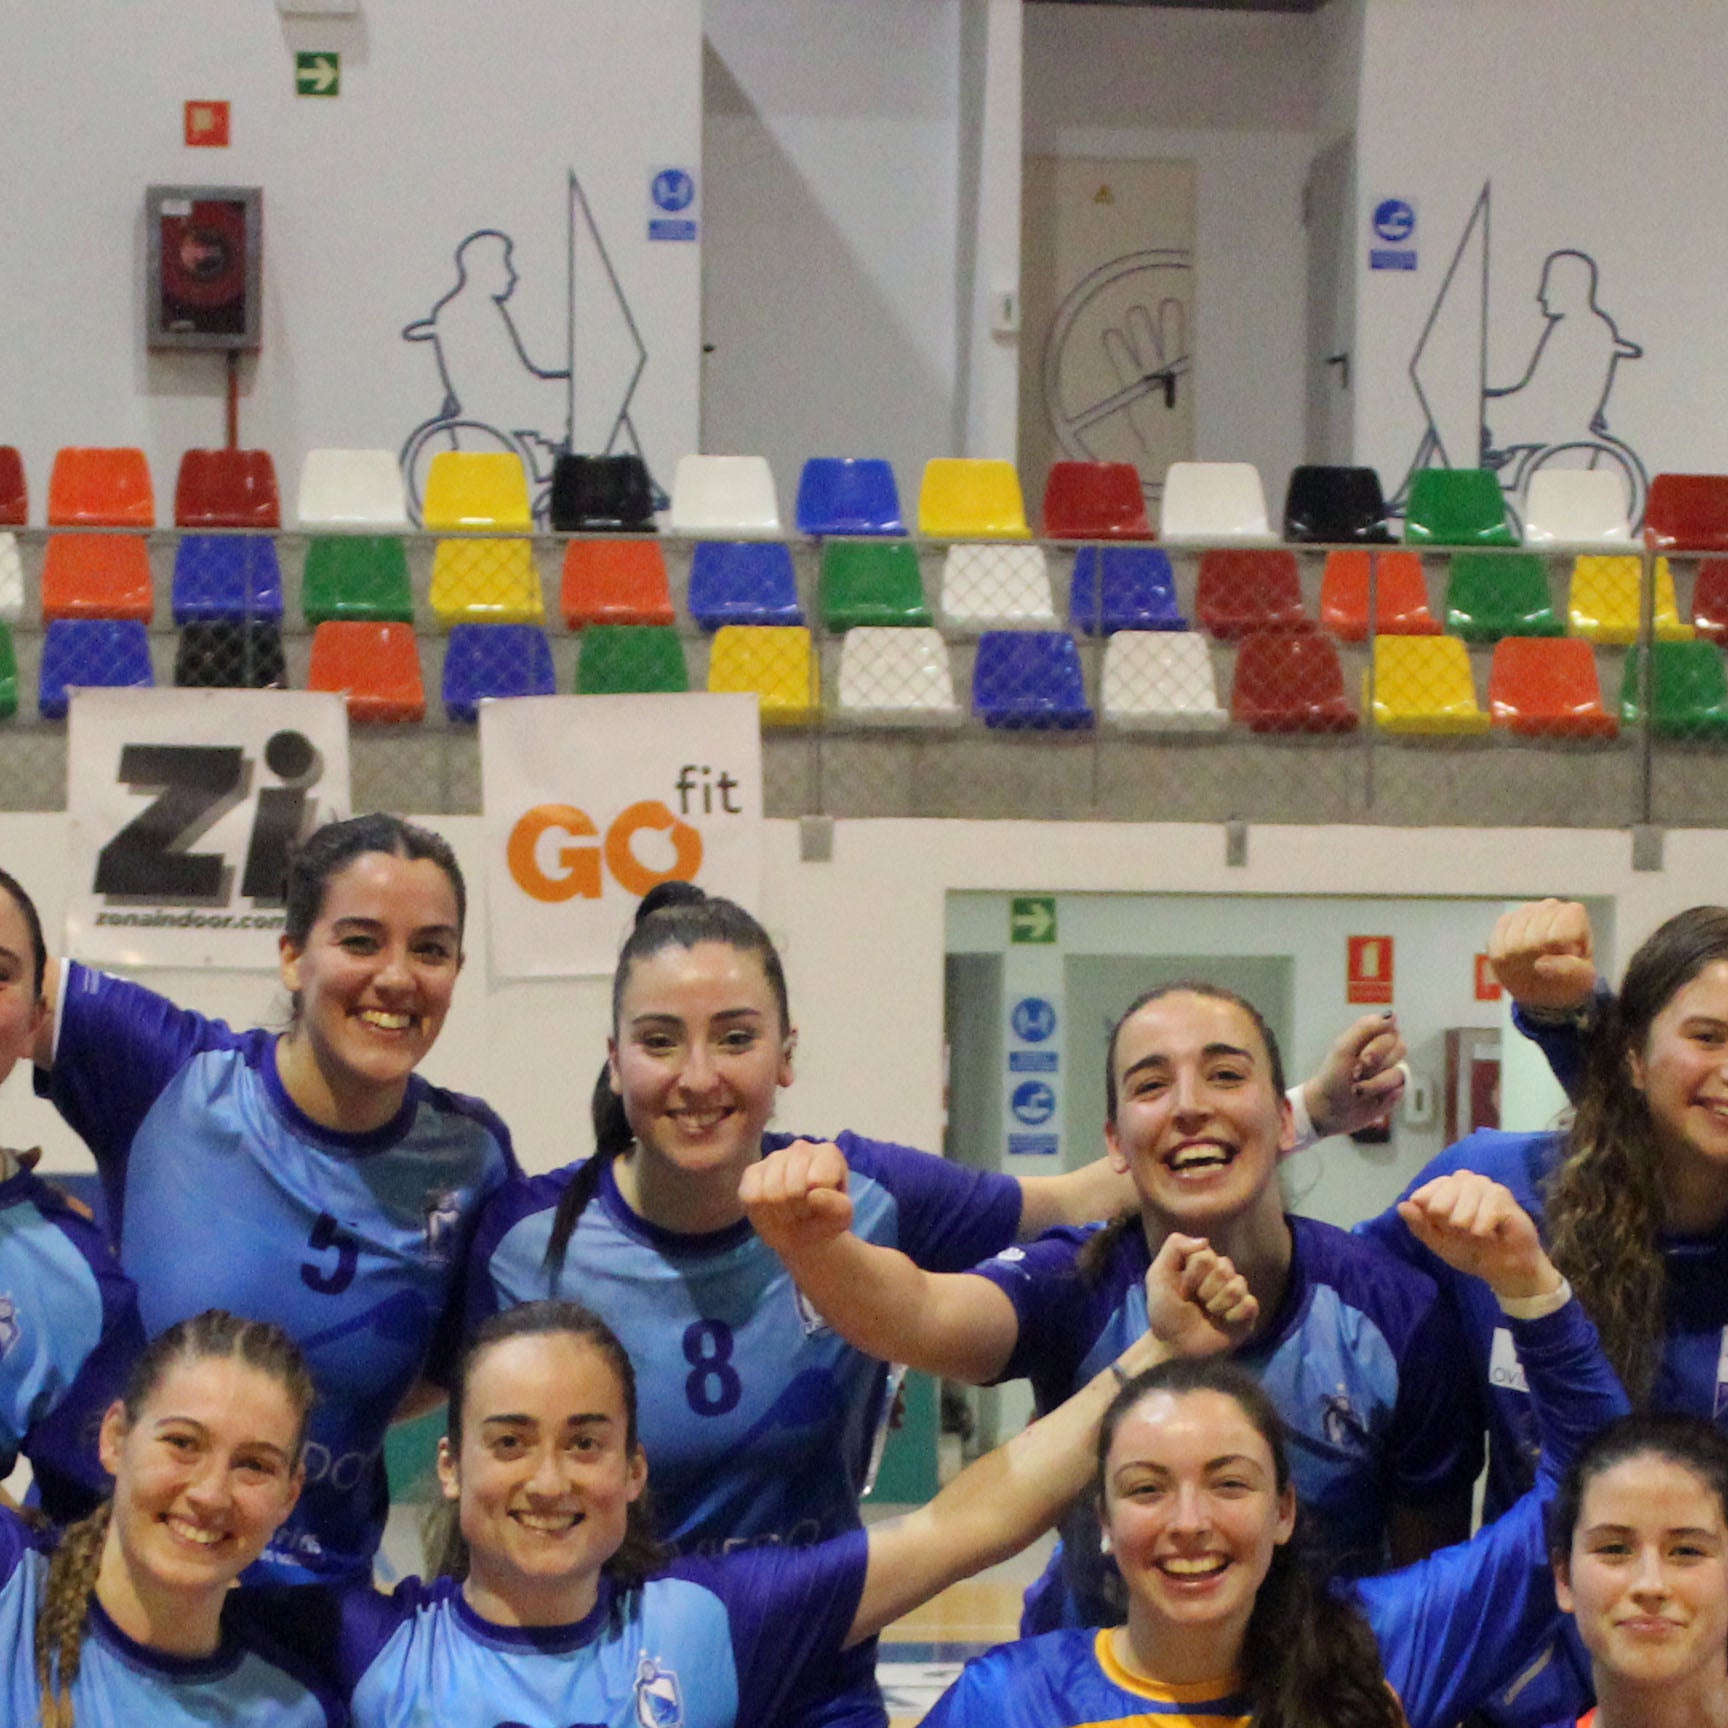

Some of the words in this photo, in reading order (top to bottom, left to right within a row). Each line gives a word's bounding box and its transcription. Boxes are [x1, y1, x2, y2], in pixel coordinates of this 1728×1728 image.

[676, 766, 742, 815] fit
[508, 800, 703, 902] GO
[300, 1213, 361, 1294] 5
[681, 1319, 742, 1416] 8
